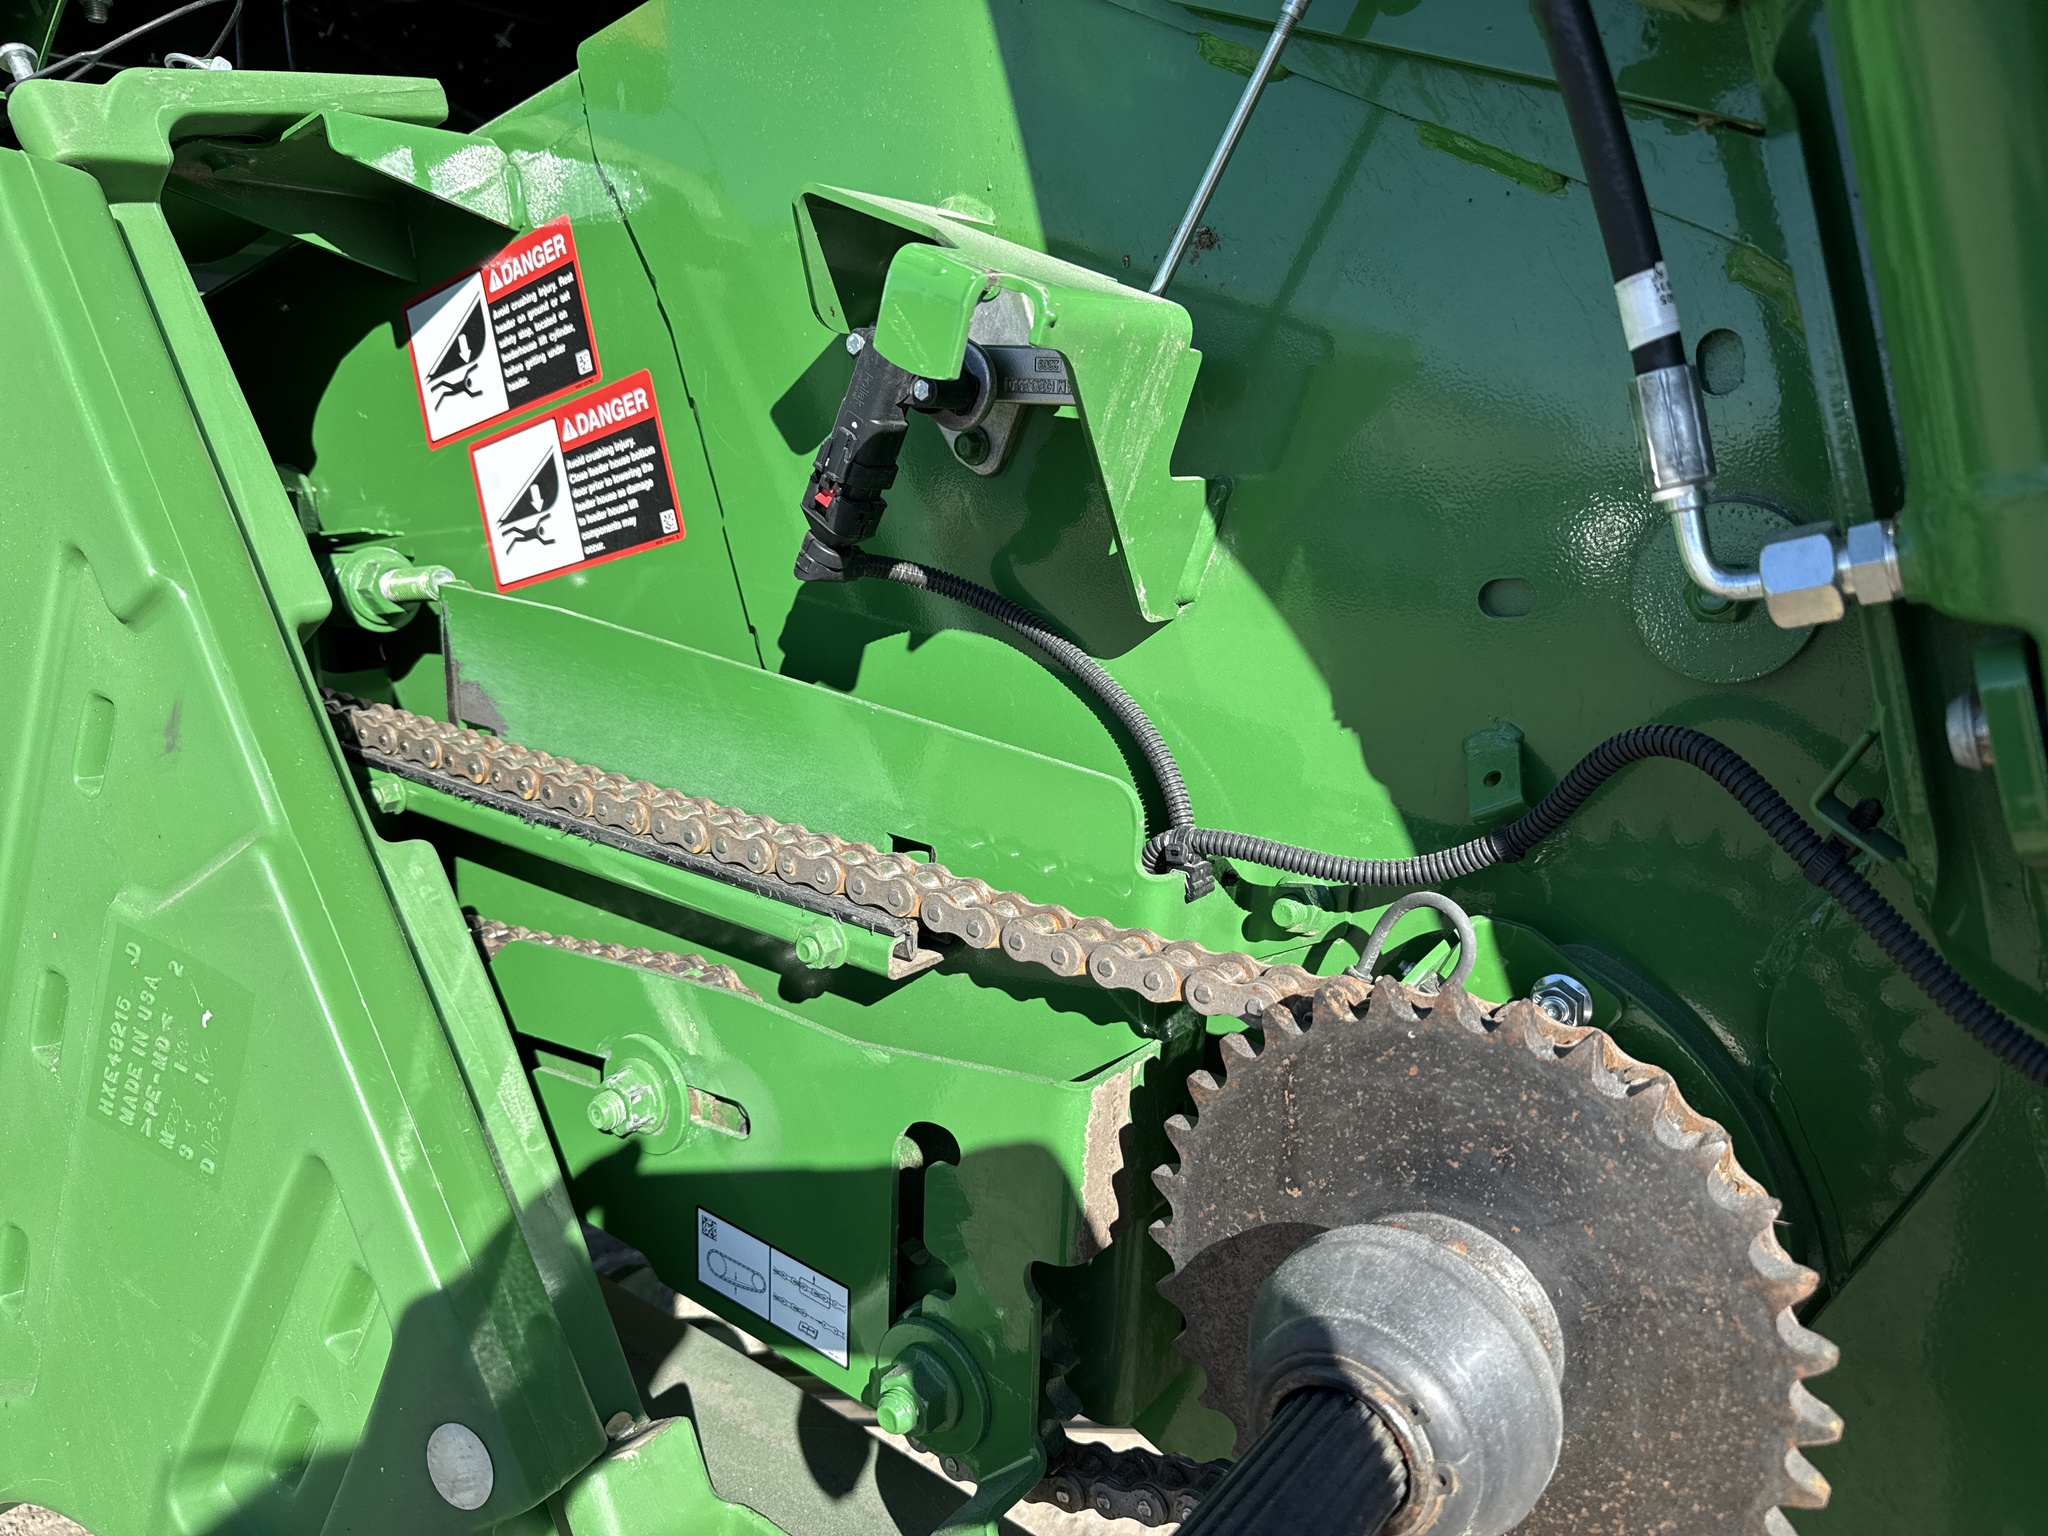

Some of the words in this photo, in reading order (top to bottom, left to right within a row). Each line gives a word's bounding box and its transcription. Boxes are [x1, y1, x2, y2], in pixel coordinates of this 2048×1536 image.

[500, 233, 567, 286] DANGER
[492, 303, 511, 320] Avoid
[510, 291, 538, 311] crushing
[537, 281, 558, 298] injury.
[557, 271, 574, 287] Rest
[494, 318, 516, 334] header
[516, 313, 527, 324] on
[526, 299, 550, 321] ground
[550, 297, 558, 308] or
[559, 290, 571, 304] set
[498, 334, 517, 349] safety
[517, 327, 534, 340] stop,
[533, 312, 558, 332] located
[558, 309, 568, 320] on
[500, 340, 538, 363] feederhouse
[537, 334, 548, 346] lift
[548, 323, 576, 342] cylinder,
[503, 363, 524, 378] before
[524, 352, 547, 371] getting
[546, 343, 566, 358] under
[506, 376, 530, 392] header.
[574, 387, 649, 436] DANGER
[566, 454, 586, 470] Avoid
[585, 444, 615, 463] crushing
[613, 437, 636, 452] injury.
[568, 470, 589, 484] Close
[587, 462, 609, 477] feeder
[608, 454, 631, 469] house
[629, 445, 656, 461] bottom
[572, 486, 588, 498] door
[588, 480, 604, 495] prior
[603, 477, 613, 487] to
[611, 466, 642, 484] lowering
[641, 462, 654, 474] the
[574, 498, 596, 512] feeder
[595, 491, 617, 505] house
[617, 488, 627, 498] as
[626, 478, 654, 495] damage
[577, 516, 587, 527] to
[585, 510, 607, 524] feeder
[606, 503, 629, 517] house
[627, 498, 639, 510] lift
[581, 520, 622, 541] components
[621, 516, 637, 528] may
[584, 541, 606, 555] occur.
[168, 960, 184, 978] 2
[137, 975, 161, 1021] USA
[98, 995, 131, 1117] HXE48215
[131, 1028, 150, 1058] IN
[119, 1062, 143, 1127] MADE
[158, 1129, 176, 1150] M
[178, 1143, 194, 1161] S
[199, 1157, 216, 1176] D
